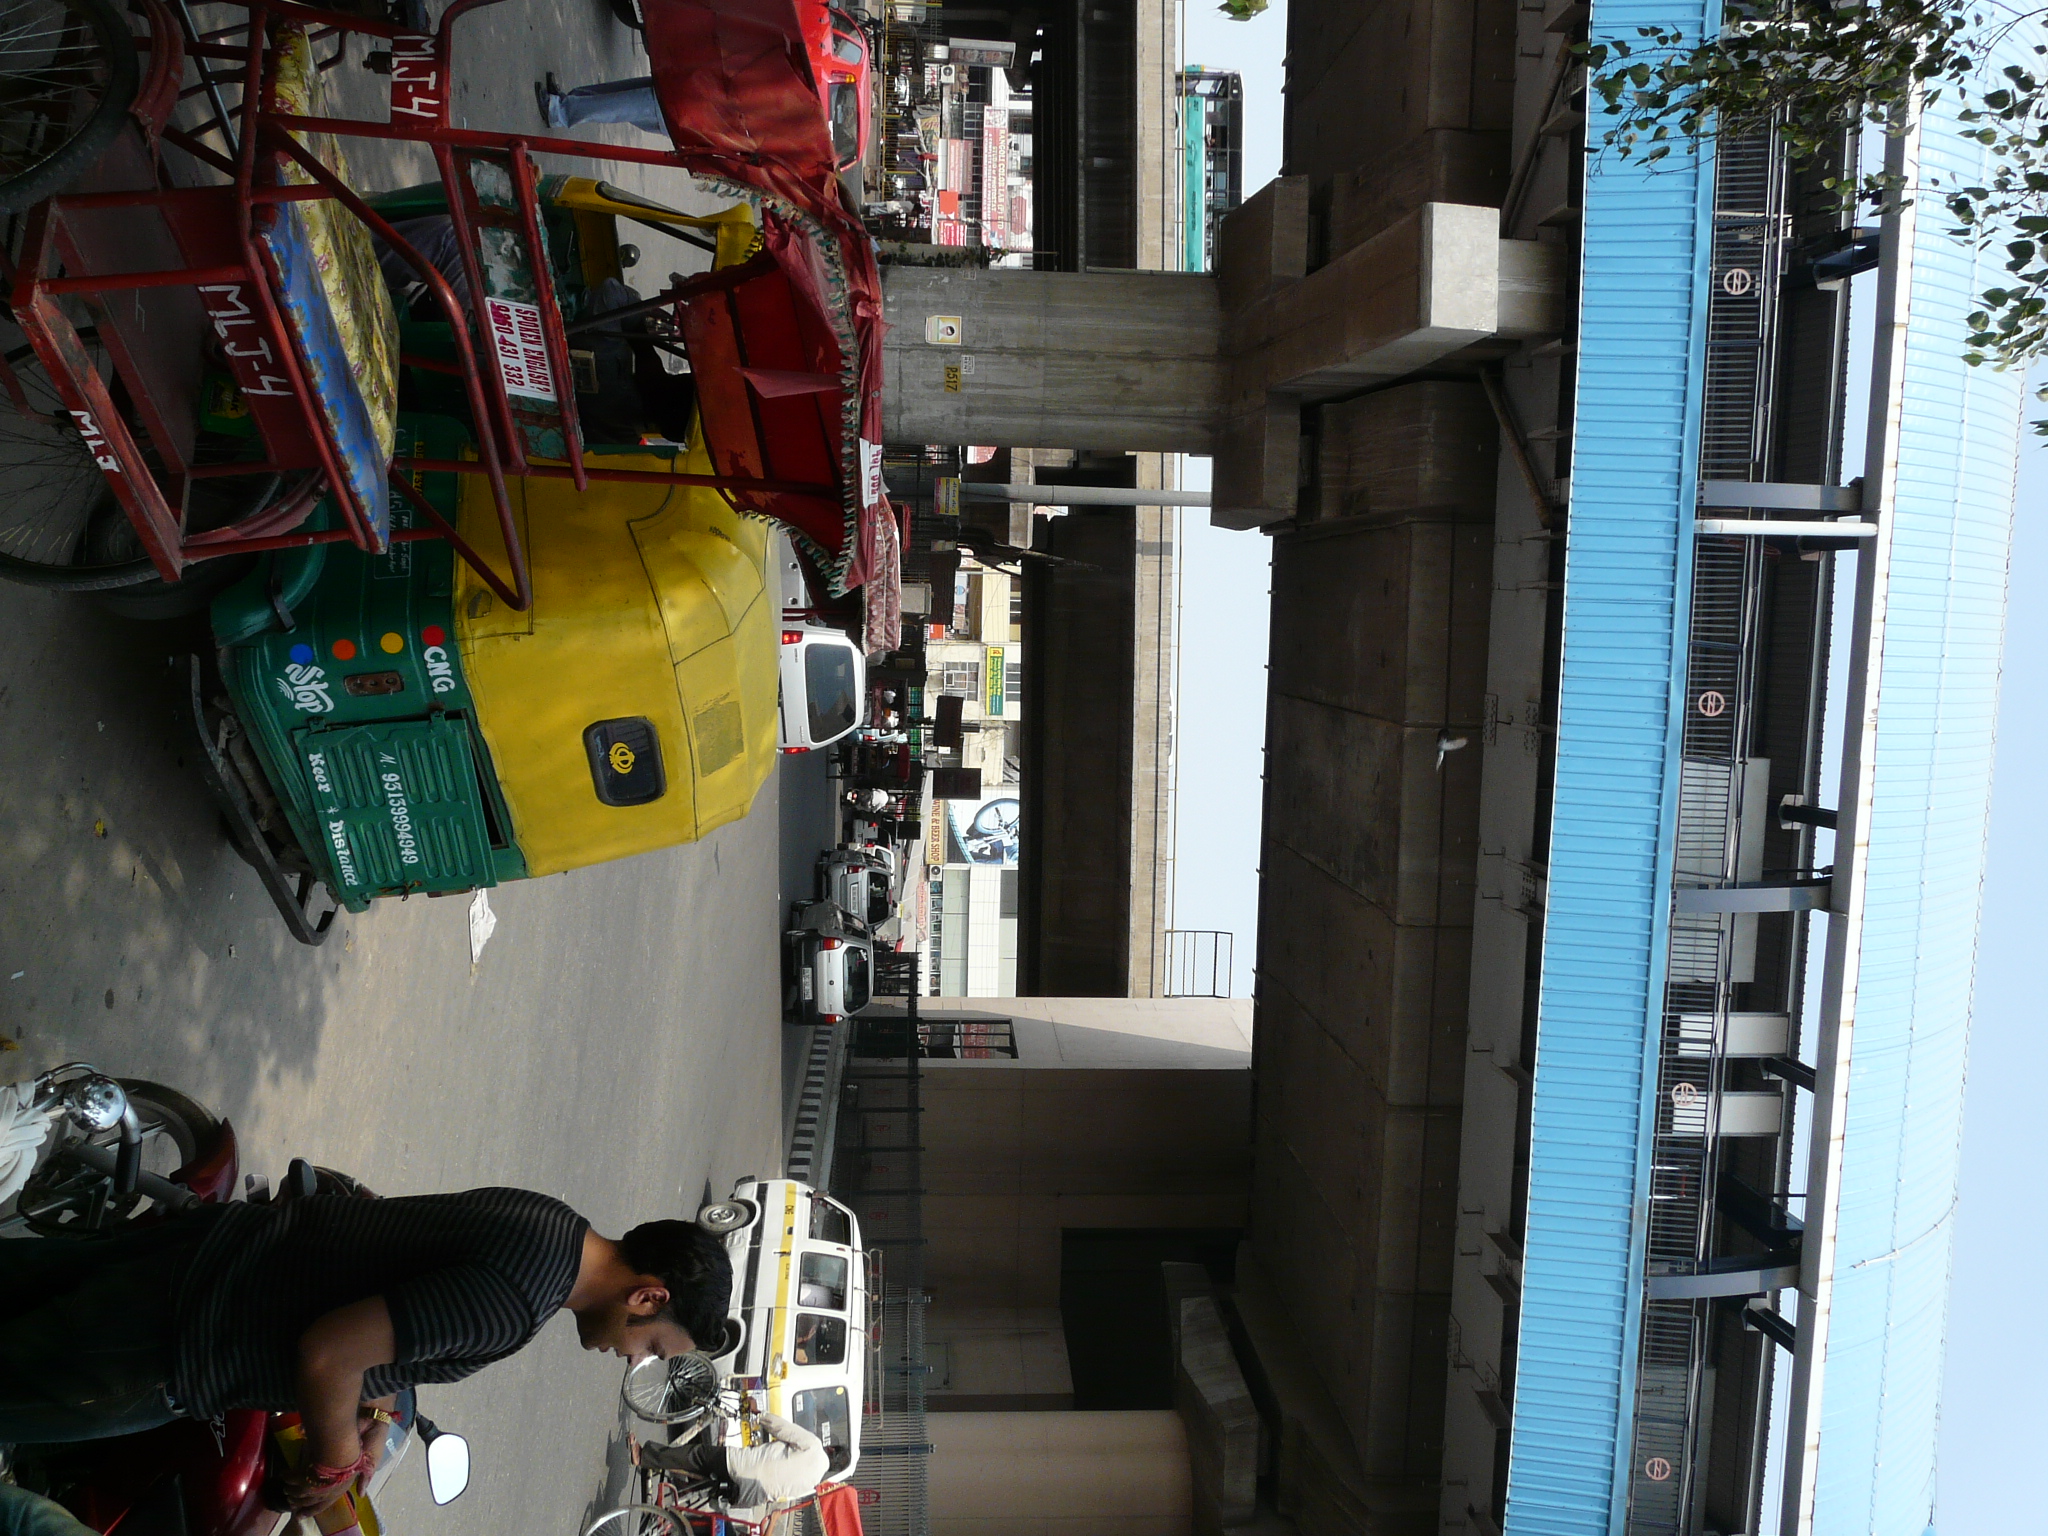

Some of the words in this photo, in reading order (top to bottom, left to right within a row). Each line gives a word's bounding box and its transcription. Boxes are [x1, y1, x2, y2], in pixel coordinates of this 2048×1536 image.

[391, 36, 440, 118] MLJ-4
[998, 129, 1006, 162] RANGOLI
[998, 163, 1006, 186] COLOR
[198, 285, 294, 396] MLJ-4
[515, 308, 542, 346] SPOKEN
[498, 336, 520, 360] 431
[503, 364, 525, 386] 332
[523, 348, 551, 392] ENGLISH?
[69, 410, 122, 473] MLJ
[284, 663, 334, 713] Stop
[424, 646, 456, 693] CNG
[308, 753, 331, 792] Keep
[329, 820, 358, 886] Distance
[931, 800, 941, 817] WINE
[930, 844, 940, 862] SHOP
[931, 826, 940, 843] BEER
